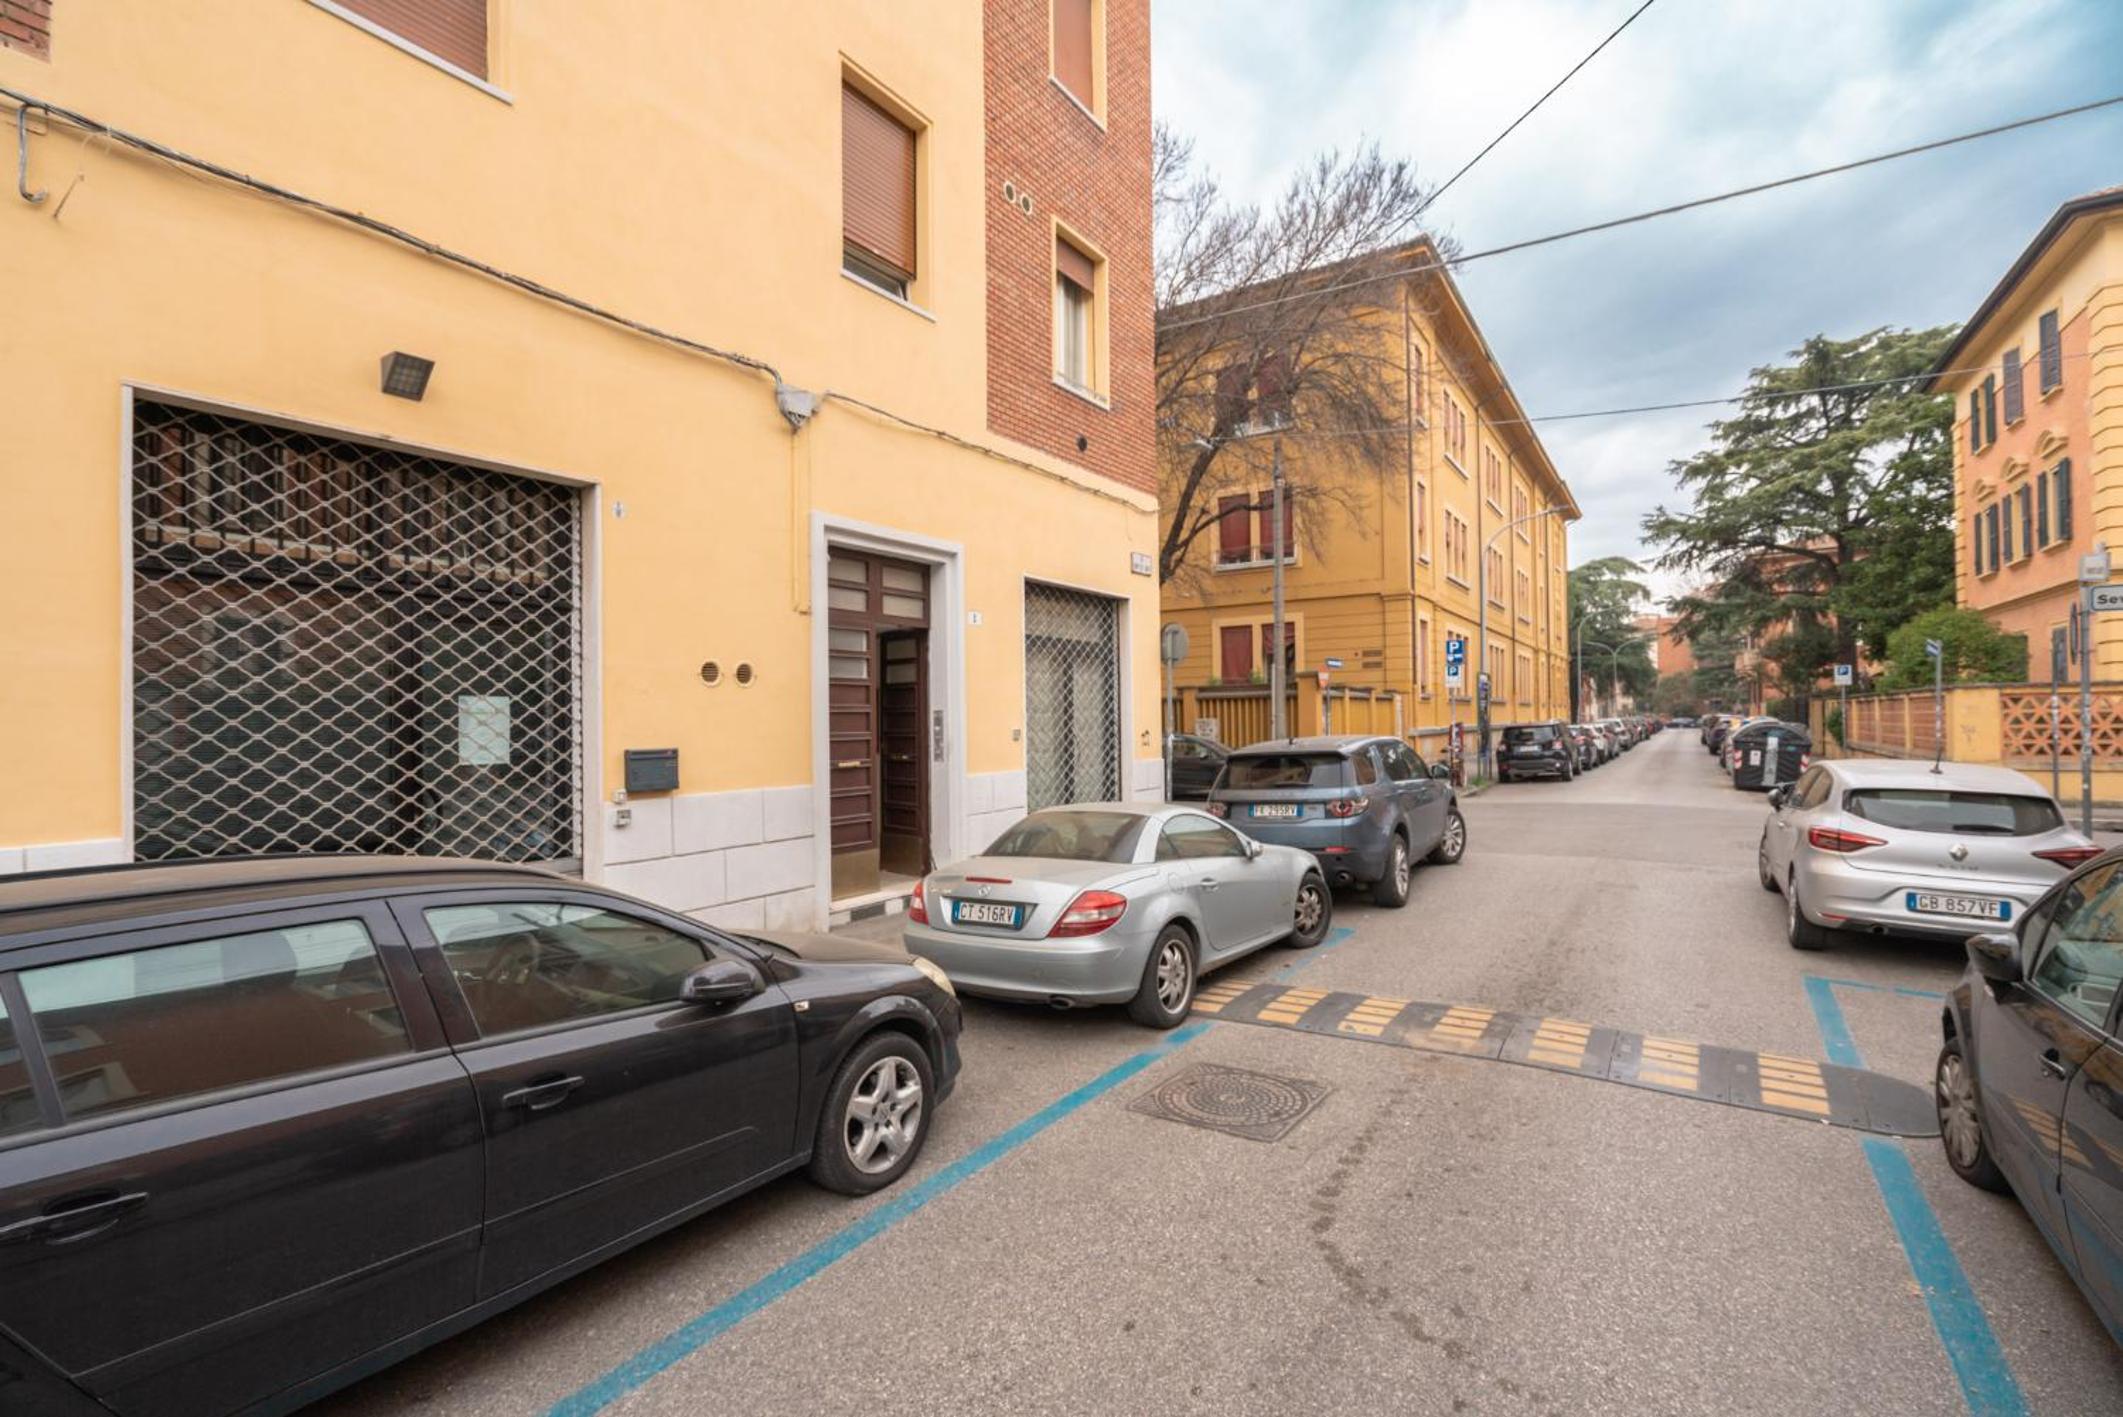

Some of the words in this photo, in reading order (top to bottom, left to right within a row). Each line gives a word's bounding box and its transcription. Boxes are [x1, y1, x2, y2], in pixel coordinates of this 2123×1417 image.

[1449, 641, 1460, 653] P
[1449, 665, 1457, 676] P
[960, 902, 974, 919] CT
[977, 904, 1014, 923] 516RV
[1946, 897, 1998, 917] 857VF
